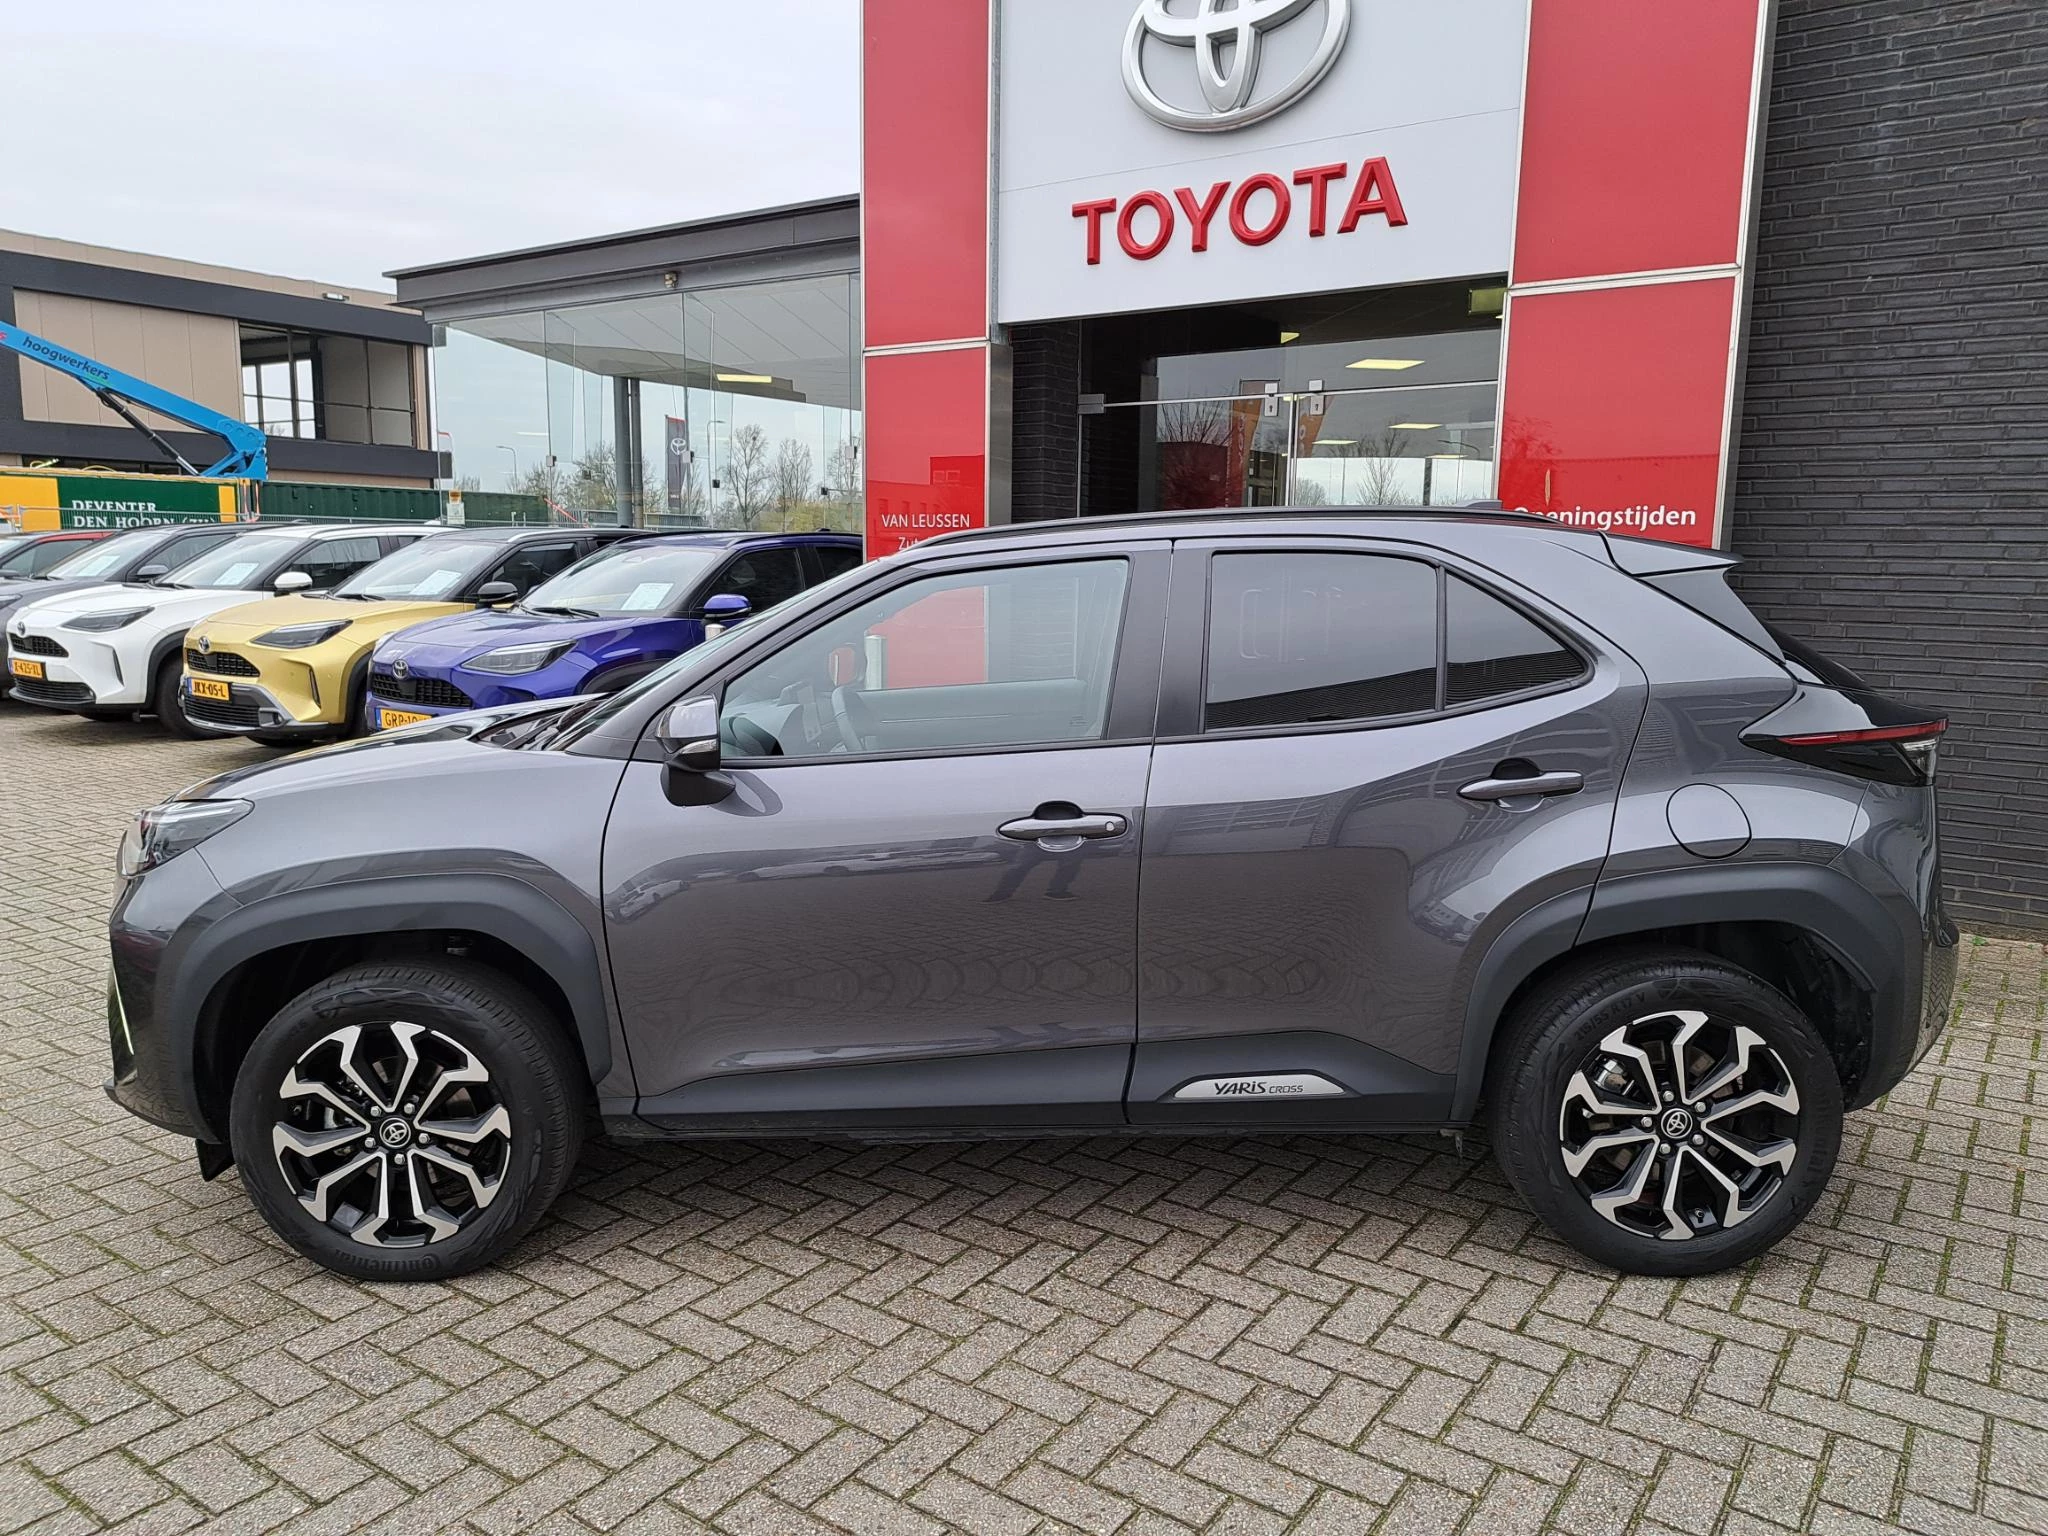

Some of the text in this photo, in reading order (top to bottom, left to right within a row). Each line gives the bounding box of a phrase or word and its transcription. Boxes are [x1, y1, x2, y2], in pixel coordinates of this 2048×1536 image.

[1072, 156, 1408, 265] TOYOTA
[22, 336, 110, 380] hoogwerkers
[72, 500, 156, 512] DEVENTER
[73, 515, 107, 528] DEN
[881, 513, 970, 528] VAN LEUSSEN
[1268, 1085, 1304, 1094] CROSS
